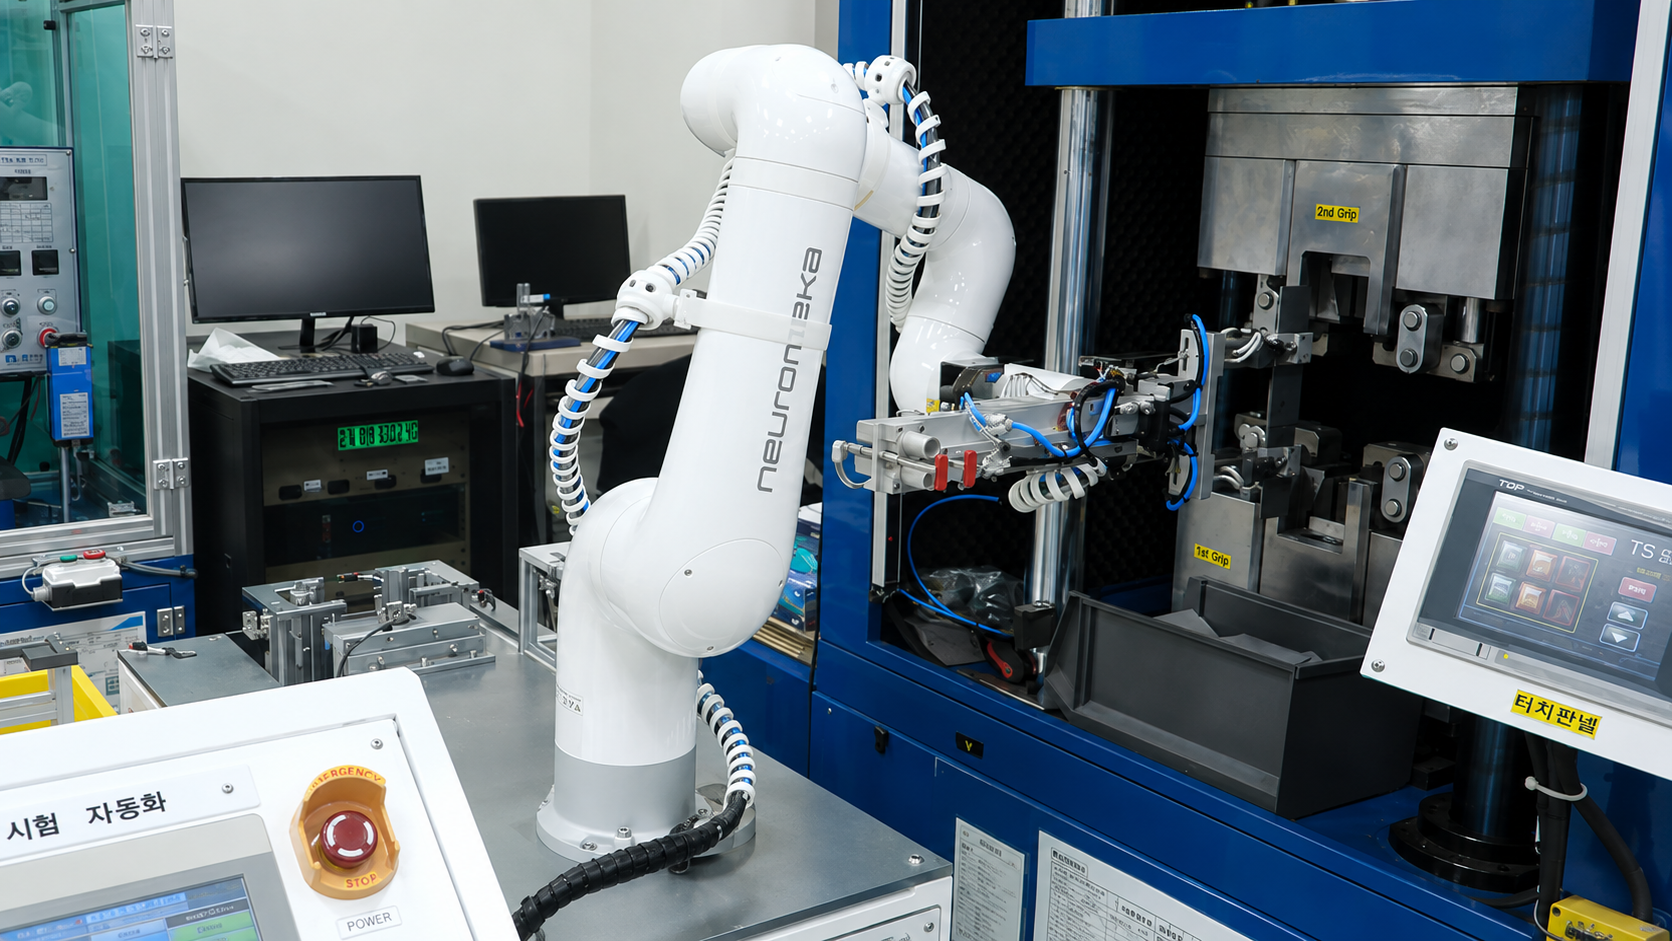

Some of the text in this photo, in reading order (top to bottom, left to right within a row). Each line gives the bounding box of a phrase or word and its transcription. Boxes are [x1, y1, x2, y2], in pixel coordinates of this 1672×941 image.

[1317, 206, 1357, 221] 2nd Grip
[1196, 546, 1229, 567] 1st Grip
[1631, 539, 1656, 559] TS
[1514, 693, 1598, 735] 터치판넬
[7, 791, 167, 841] 시험 자동화
[346, 873, 377, 889] STOP
[346, 912, 393, 932] POWER
